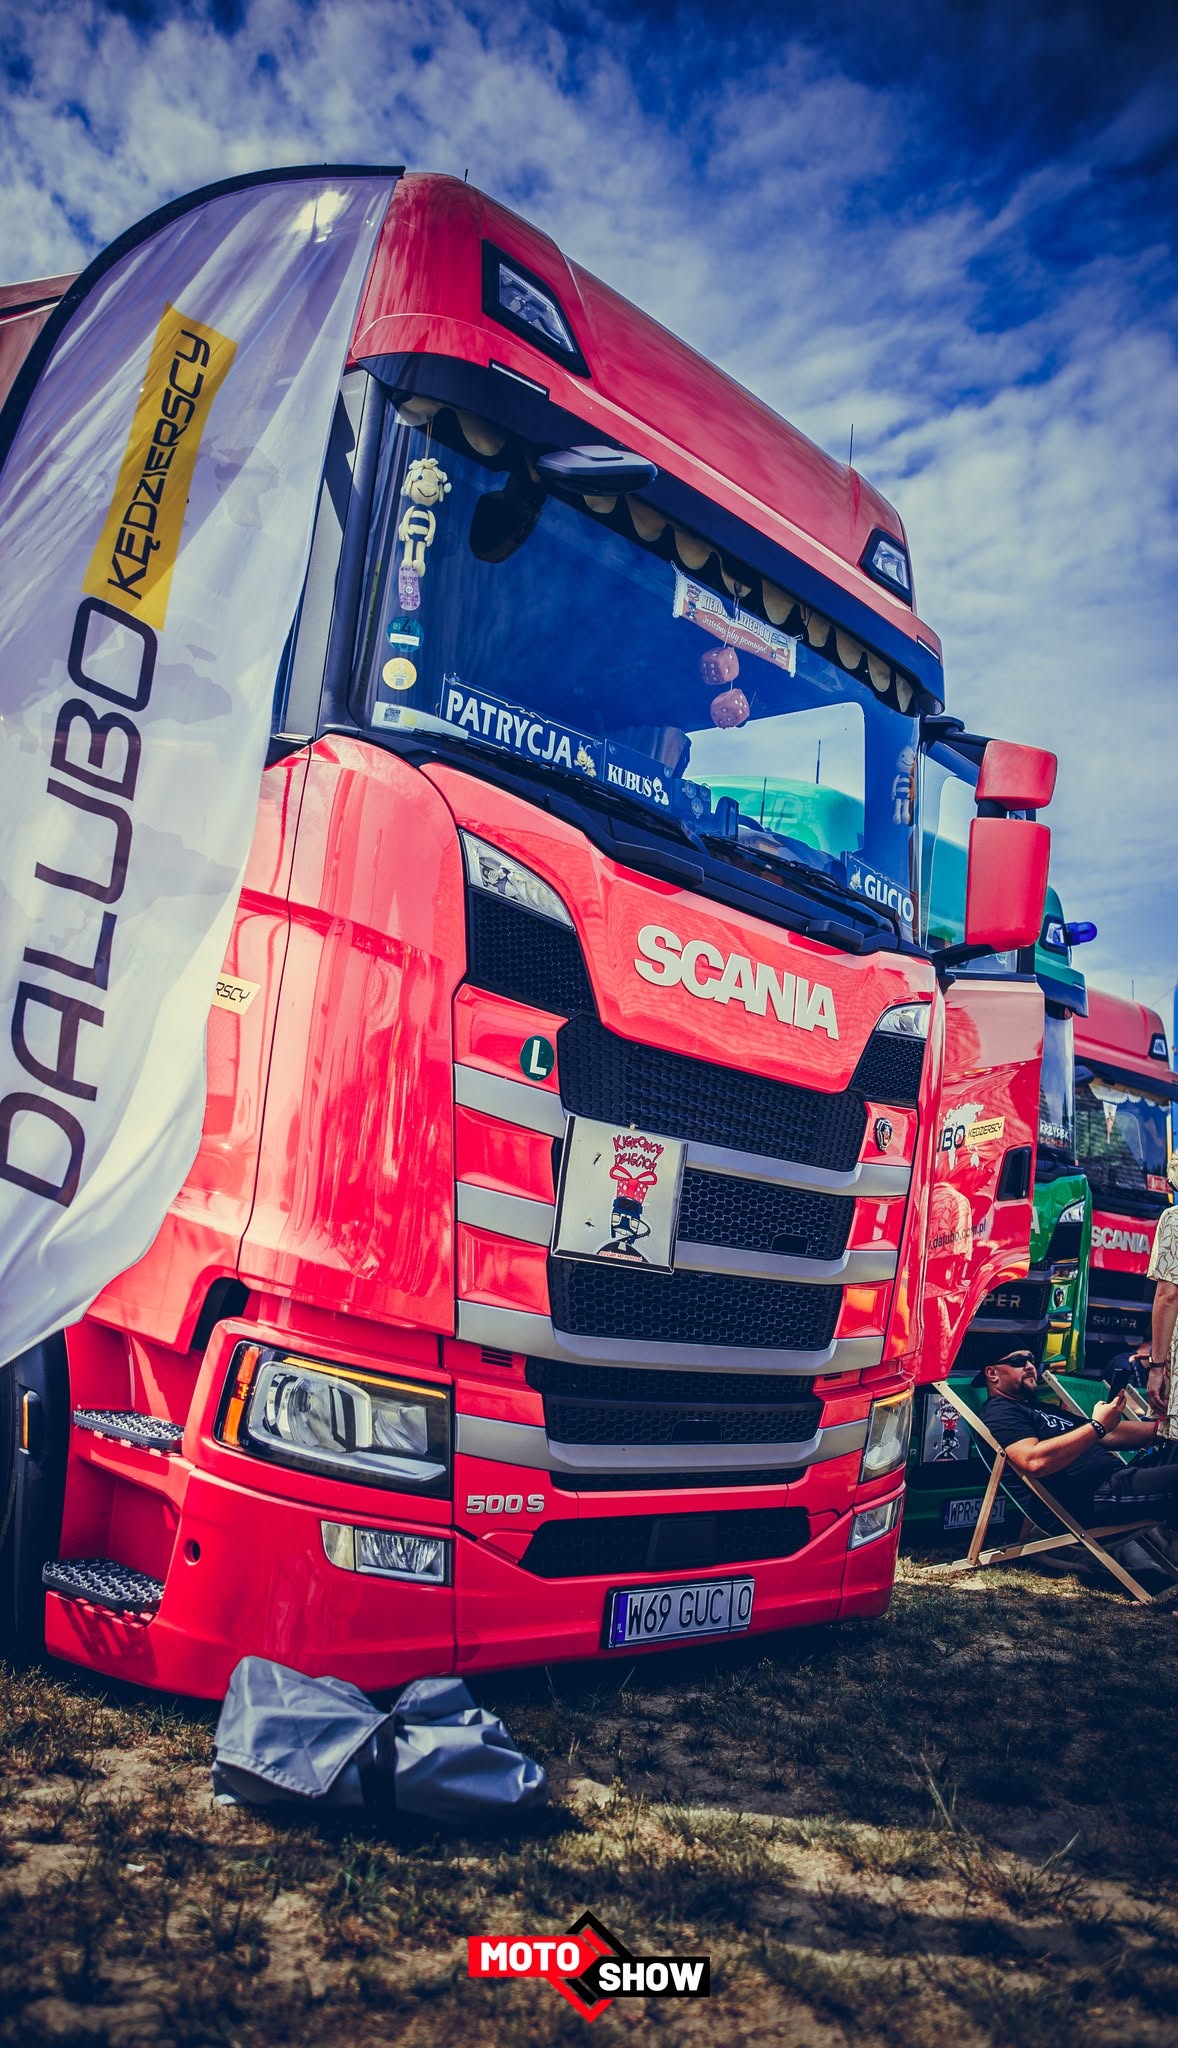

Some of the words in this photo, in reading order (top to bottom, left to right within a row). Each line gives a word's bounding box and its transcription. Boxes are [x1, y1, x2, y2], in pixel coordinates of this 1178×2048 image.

[446, 689, 573, 769] PATRYCJA
[0, 595, 158, 1207] DALUBO
[107, 329, 211, 600] KĘDZIERSCY
[607, 763, 652, 798] KUBUŚ
[864, 874, 915, 923] GUCIO
[634, 924, 839, 1041] SCANIA
[529, 1039, 547, 1076] L
[1091, 1225, 1150, 1255] SCANIA
[466, 1494, 523, 1514] 500
[526, 1494, 545, 1513] S
[628, 1593, 672, 1636] W69
